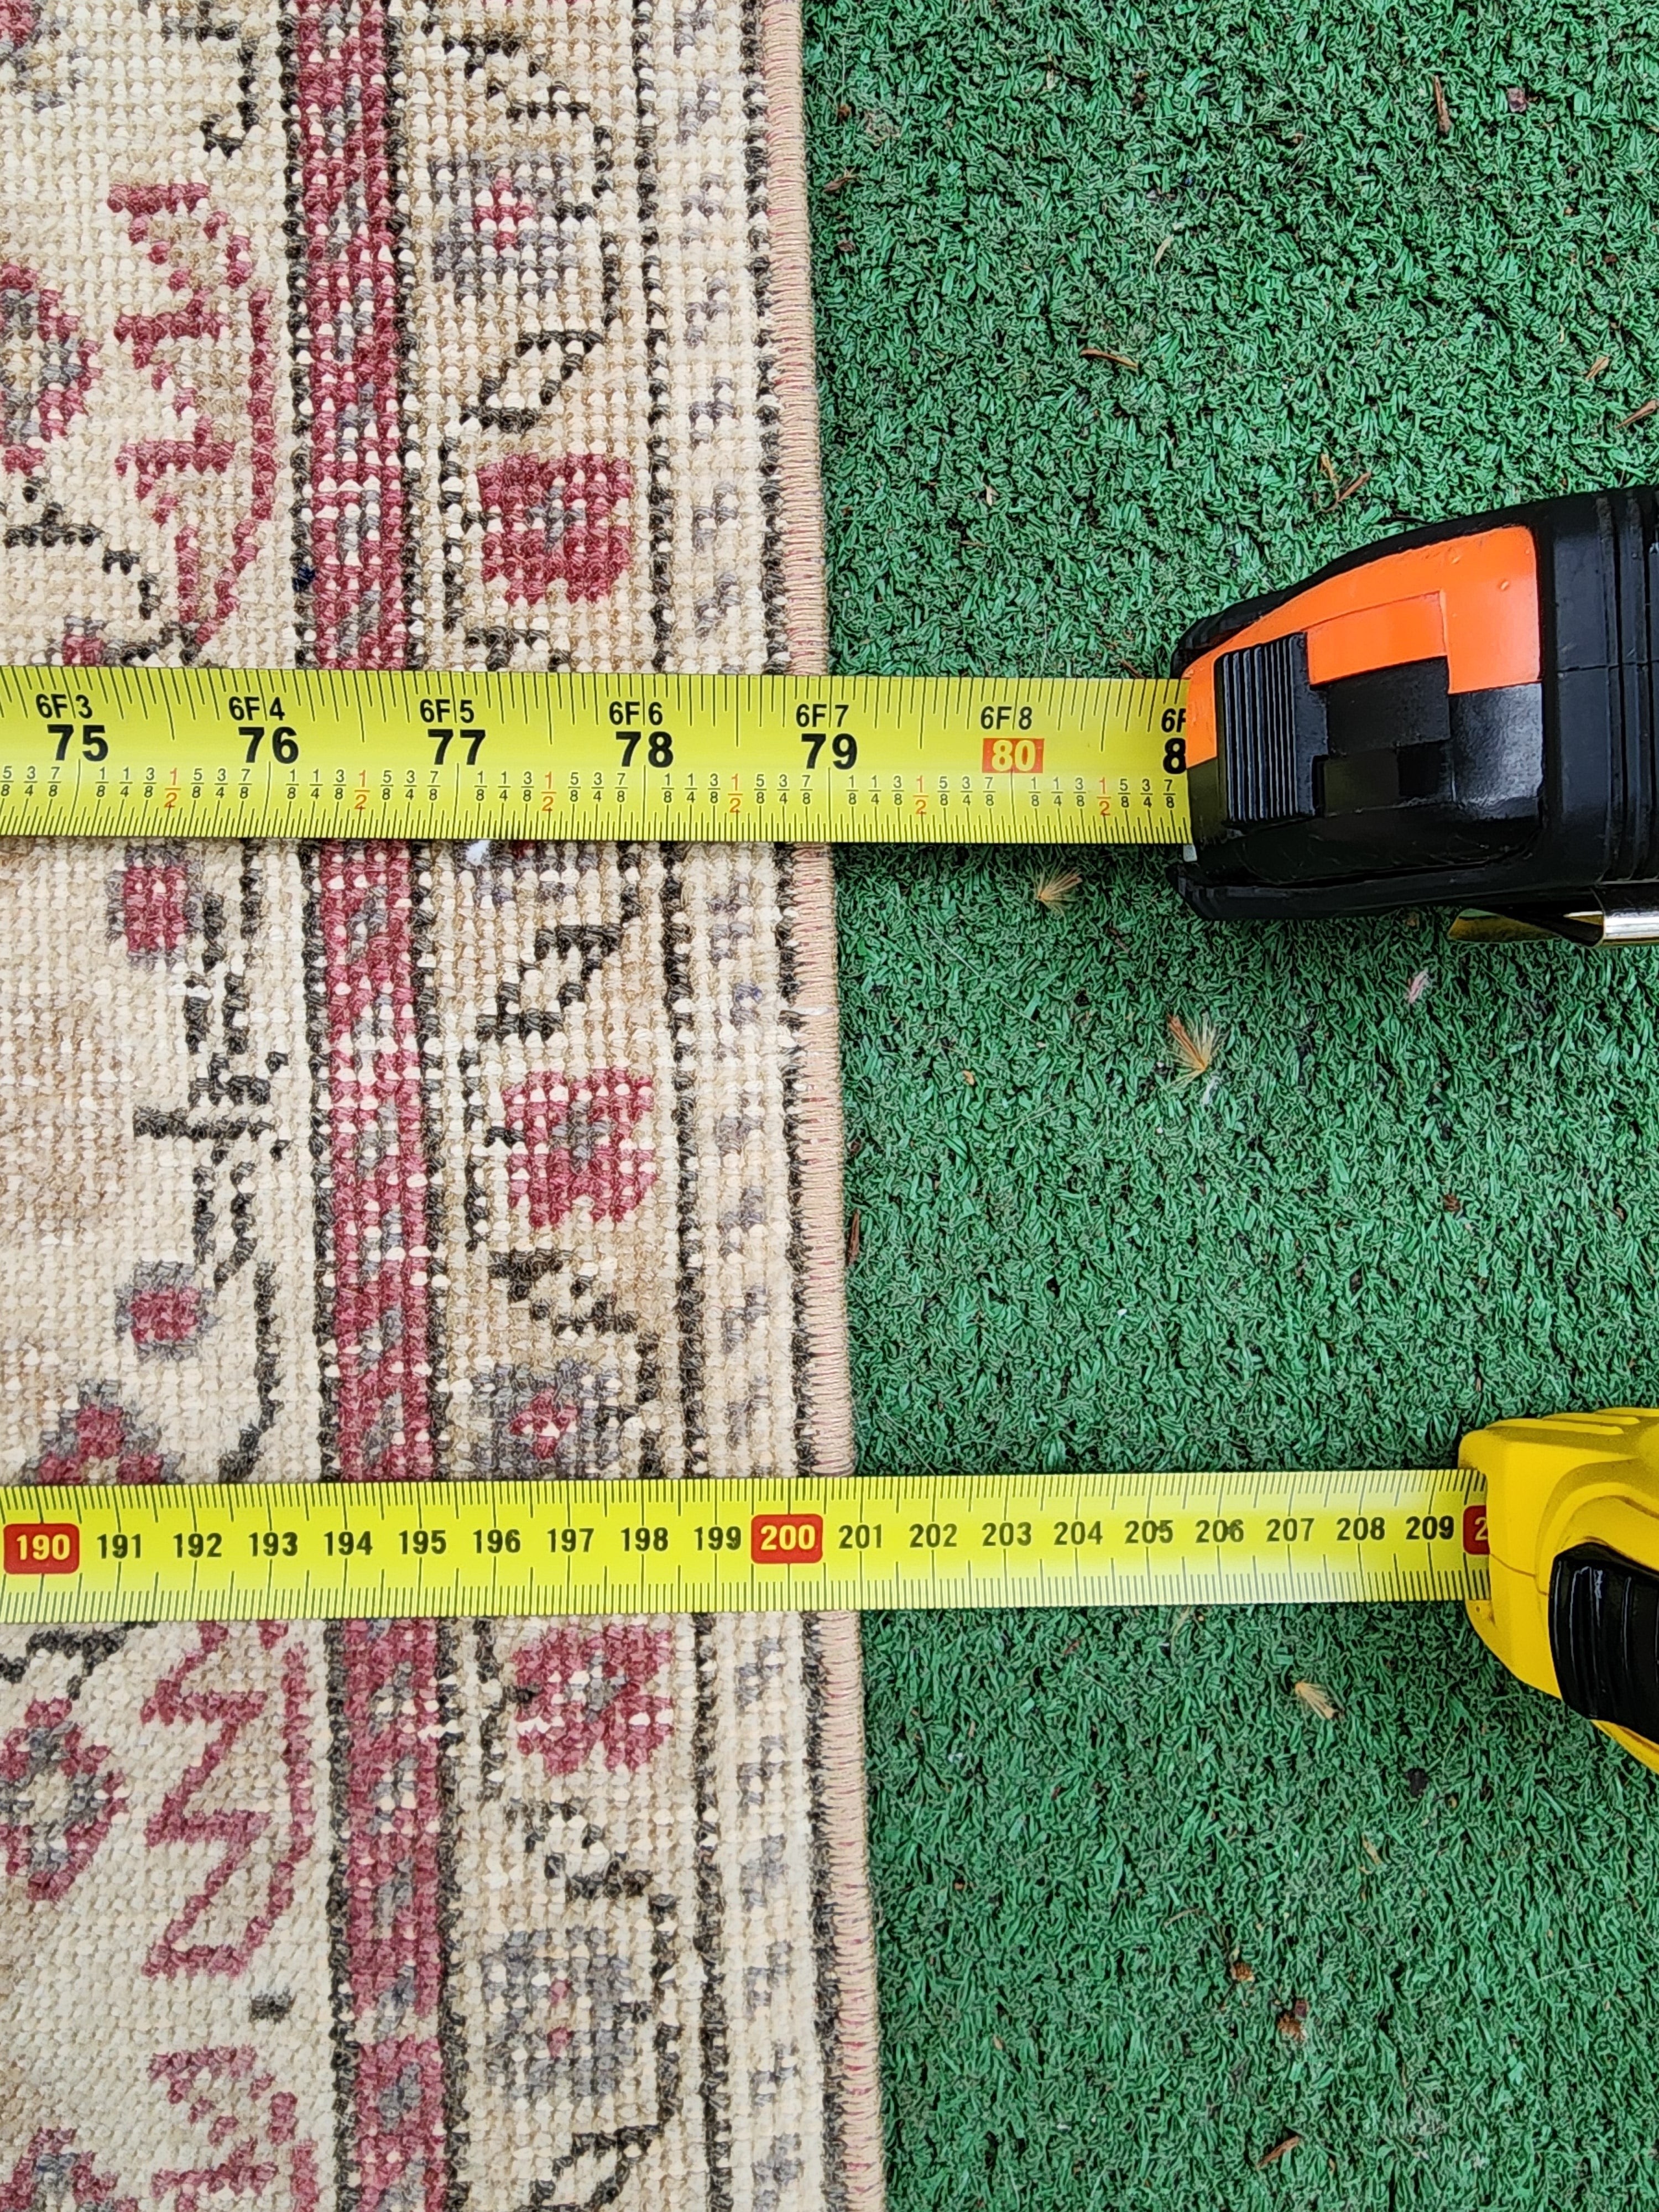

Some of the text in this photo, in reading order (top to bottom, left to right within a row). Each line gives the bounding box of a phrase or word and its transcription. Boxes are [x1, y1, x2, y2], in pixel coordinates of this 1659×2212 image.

[47, 723, 108, 762] 75
[238, 726, 299, 764] 76
[427, 728, 486, 766] 77
[615, 730, 674, 768] 78
[801, 733, 858, 770] 79
[992, 739, 1036, 772] 80
[15, 1533, 71, 1561] 190
[97, 1533, 142, 1559] 191
[173, 1532, 222, 1558] 192
[248, 1531, 298, 1557] 193
[324, 1531, 373, 1556] 194
[399, 1530, 447, 1555] 195
[473, 1529, 521, 1554] 196
[547, 1528, 594, 1553] 197
[620, 1526, 669, 1552] 198
[693, 1526, 742, 1551] 199
[760, 1525, 816, 1551] 200
[838, 1524, 882, 1549] 201
[909, 1523, 958, 1548] 202
[982, 1521, 1032, 1547] 203
[1053, 1521, 1103, 1546] 204
[1125, 1520, 1173, 1545] 205
[1195, 1519, 1244, 1543] 206
[1266, 1517, 1315, 1542] 207
[1336, 1517, 1385, 1541] 208
[1405, 1515, 1455, 1540] 209
